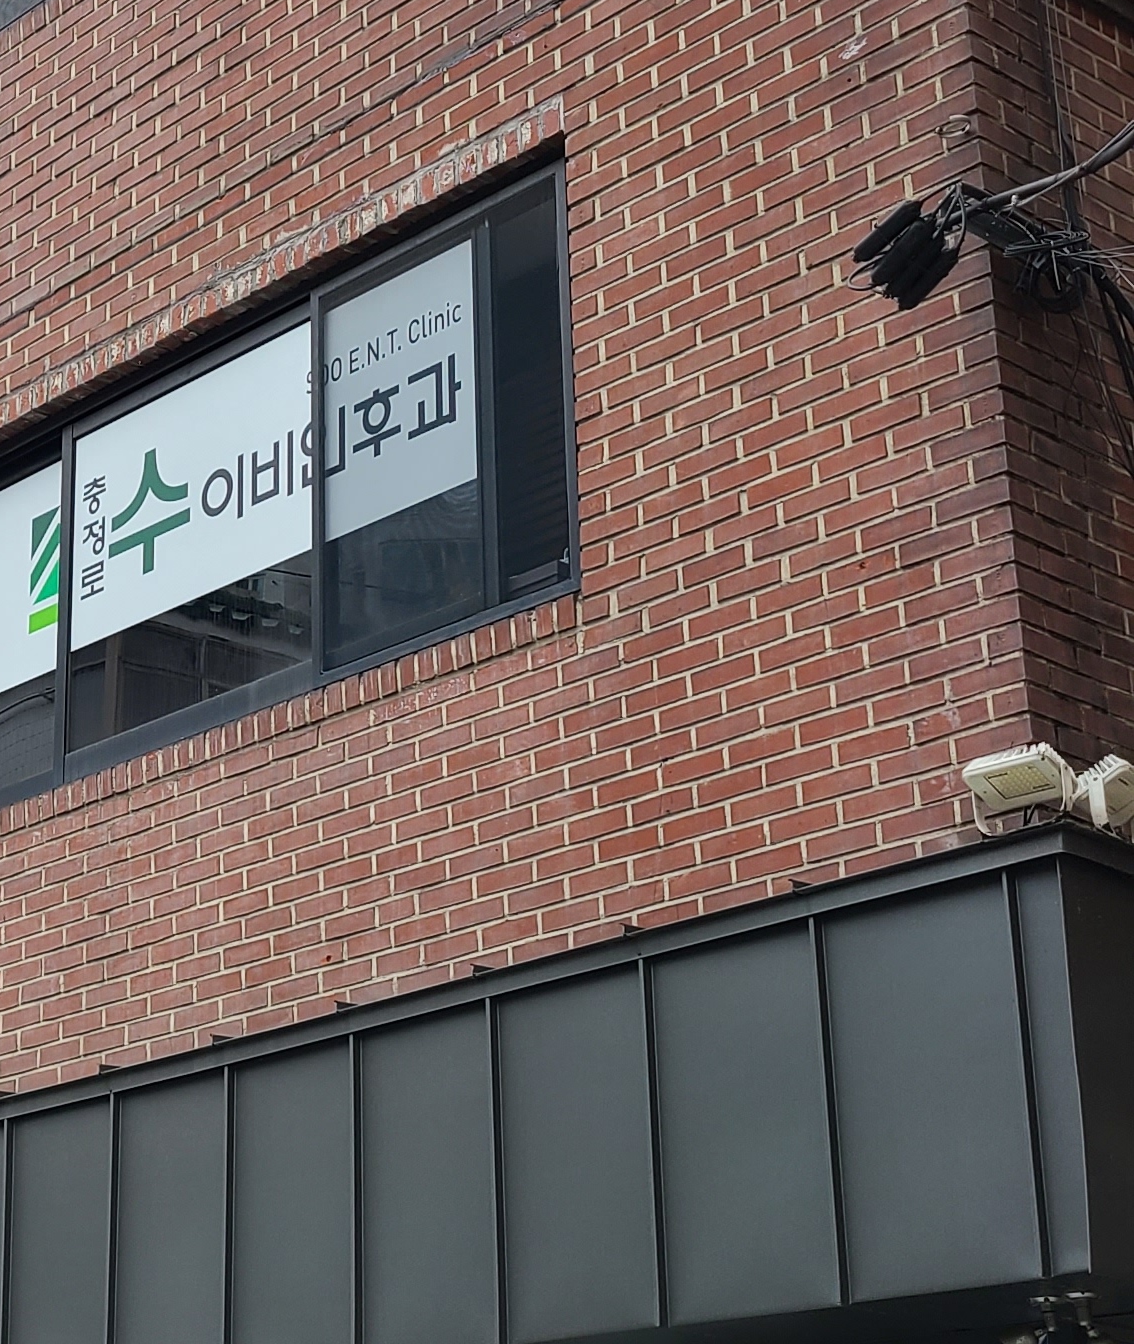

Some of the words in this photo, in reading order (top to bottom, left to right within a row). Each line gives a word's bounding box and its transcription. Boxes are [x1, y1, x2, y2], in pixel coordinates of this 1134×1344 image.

[349, 327, 402, 375] E.N.T.
[408, 302, 462, 344] Clinic
[80, 475, 107, 601] 충정로
